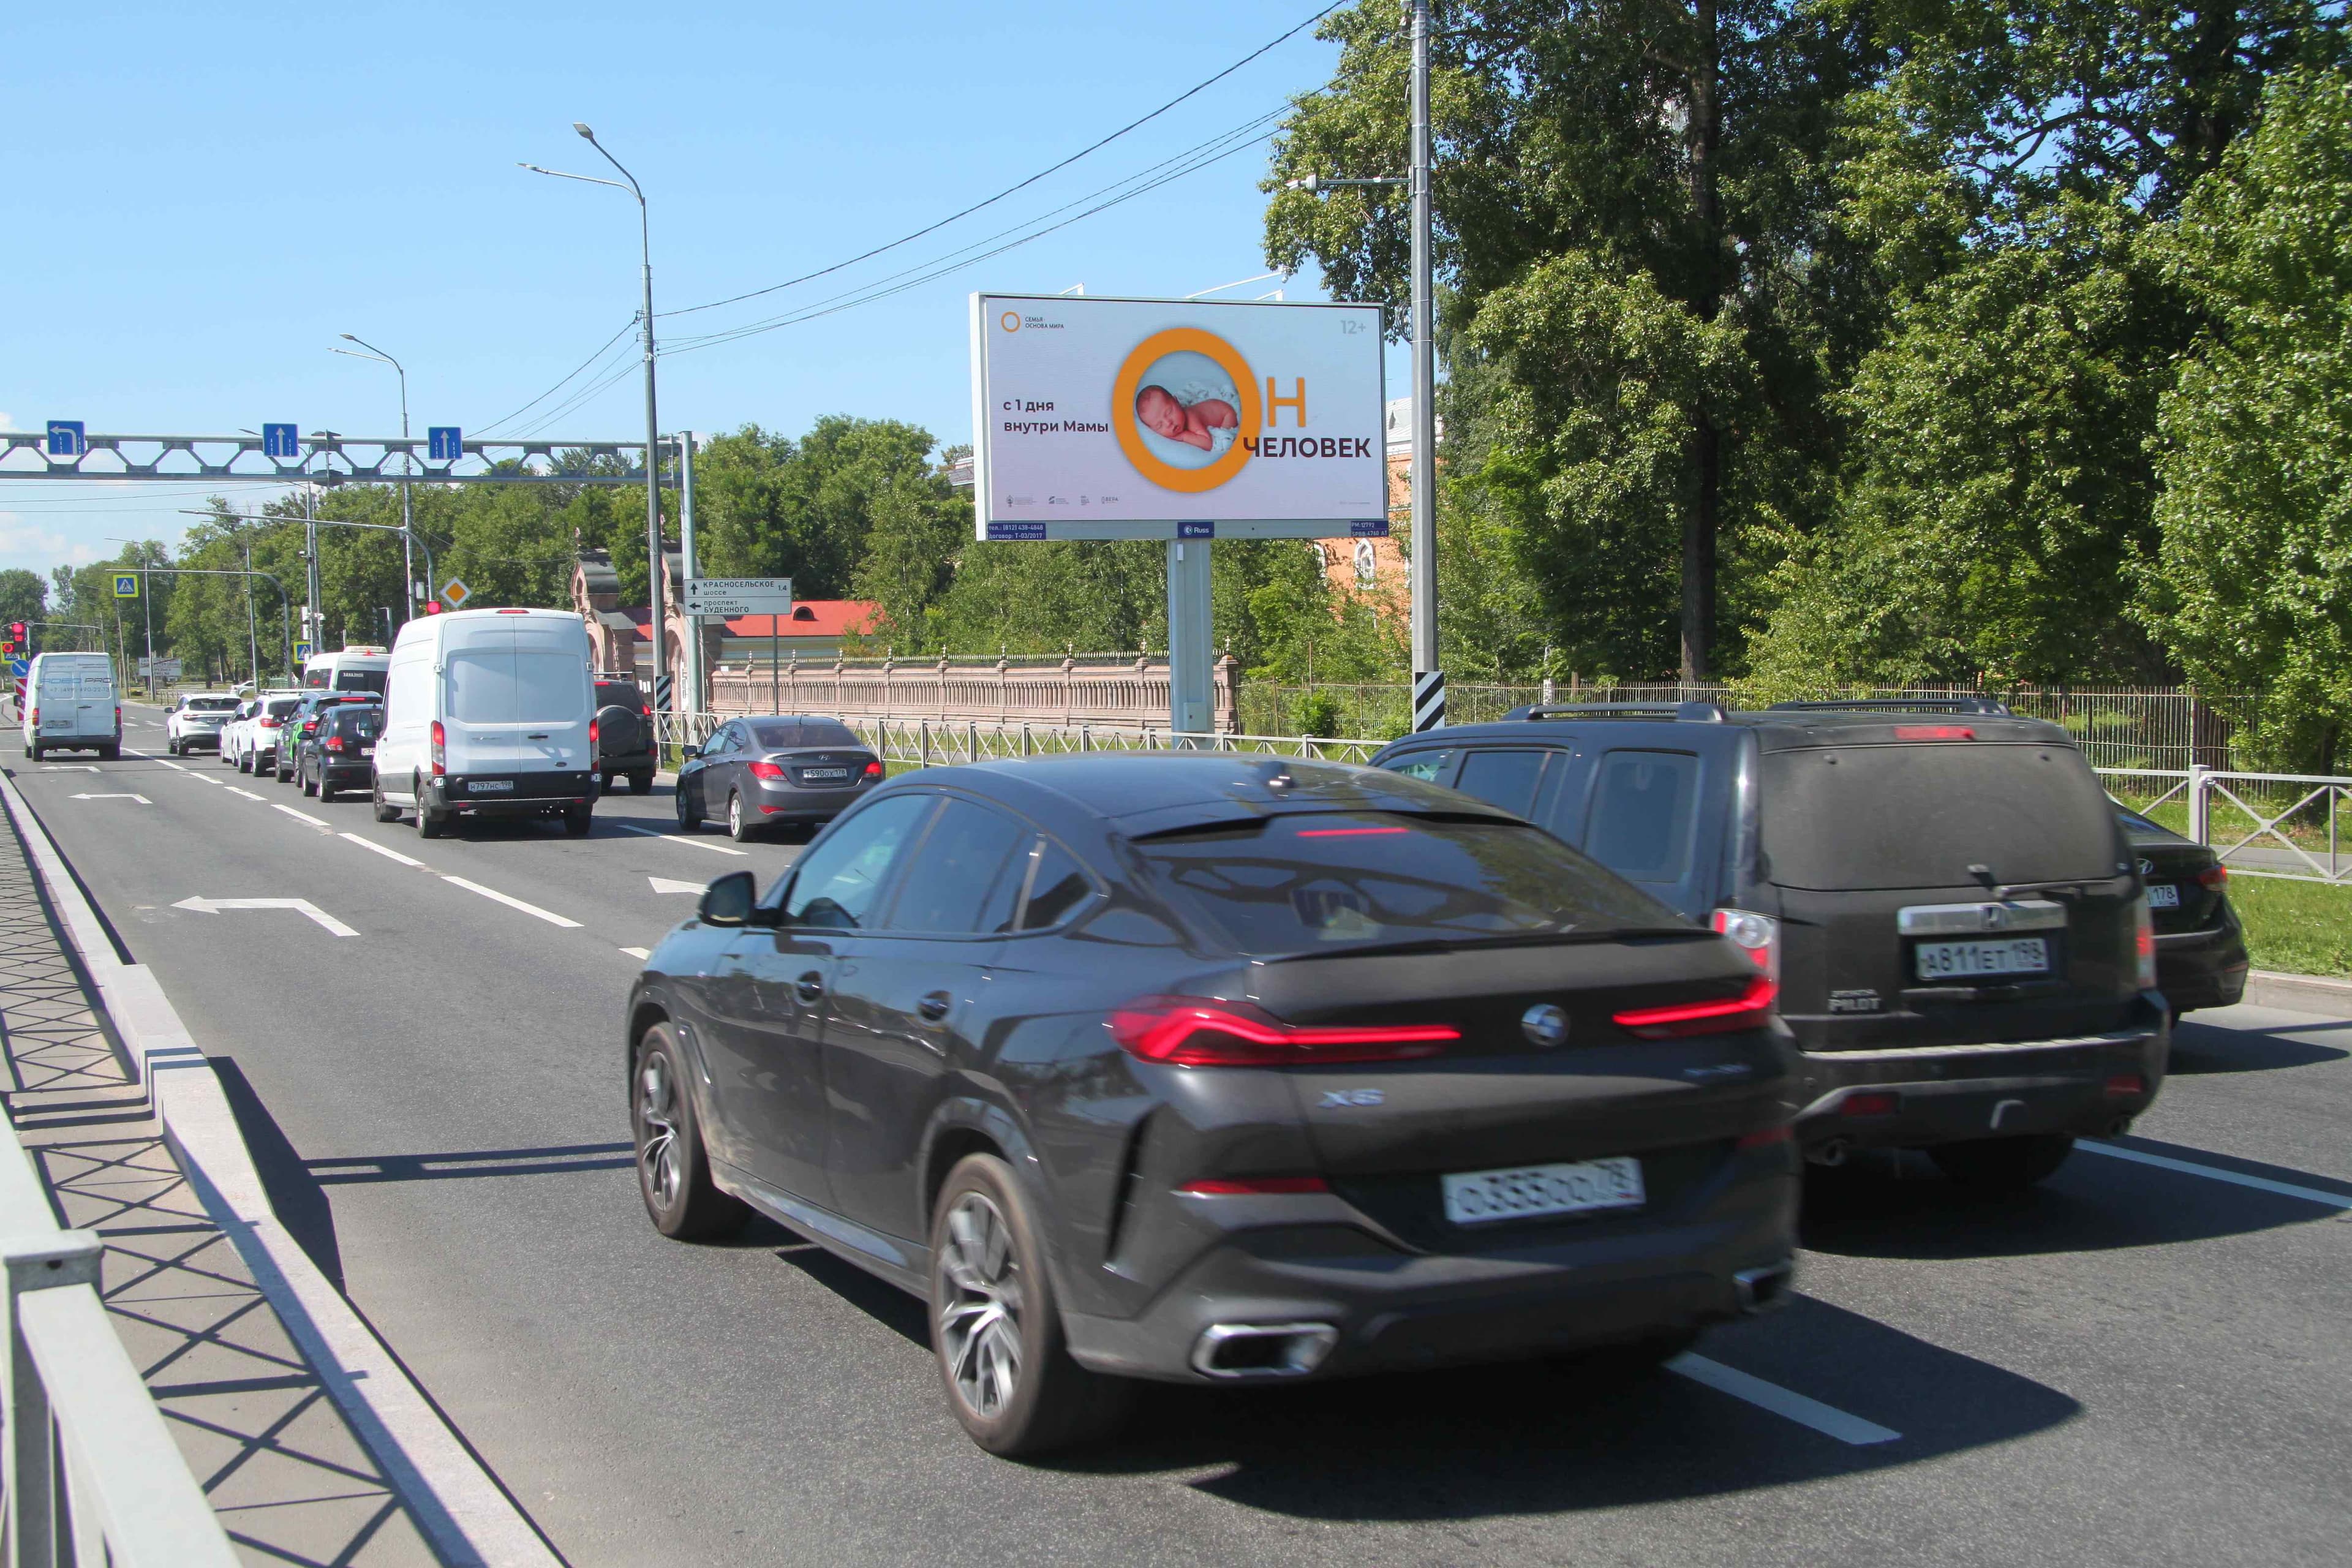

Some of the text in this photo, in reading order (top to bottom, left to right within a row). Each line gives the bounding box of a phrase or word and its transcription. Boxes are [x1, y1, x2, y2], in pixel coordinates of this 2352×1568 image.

[1340, 320, 1366, 334] 12+
[1003, 399, 1054, 413] с 1 дня
[1004, 421, 1109, 434] внутри Мамы
[1243, 437, 1371, 458] ЧЕЛОВЕК
